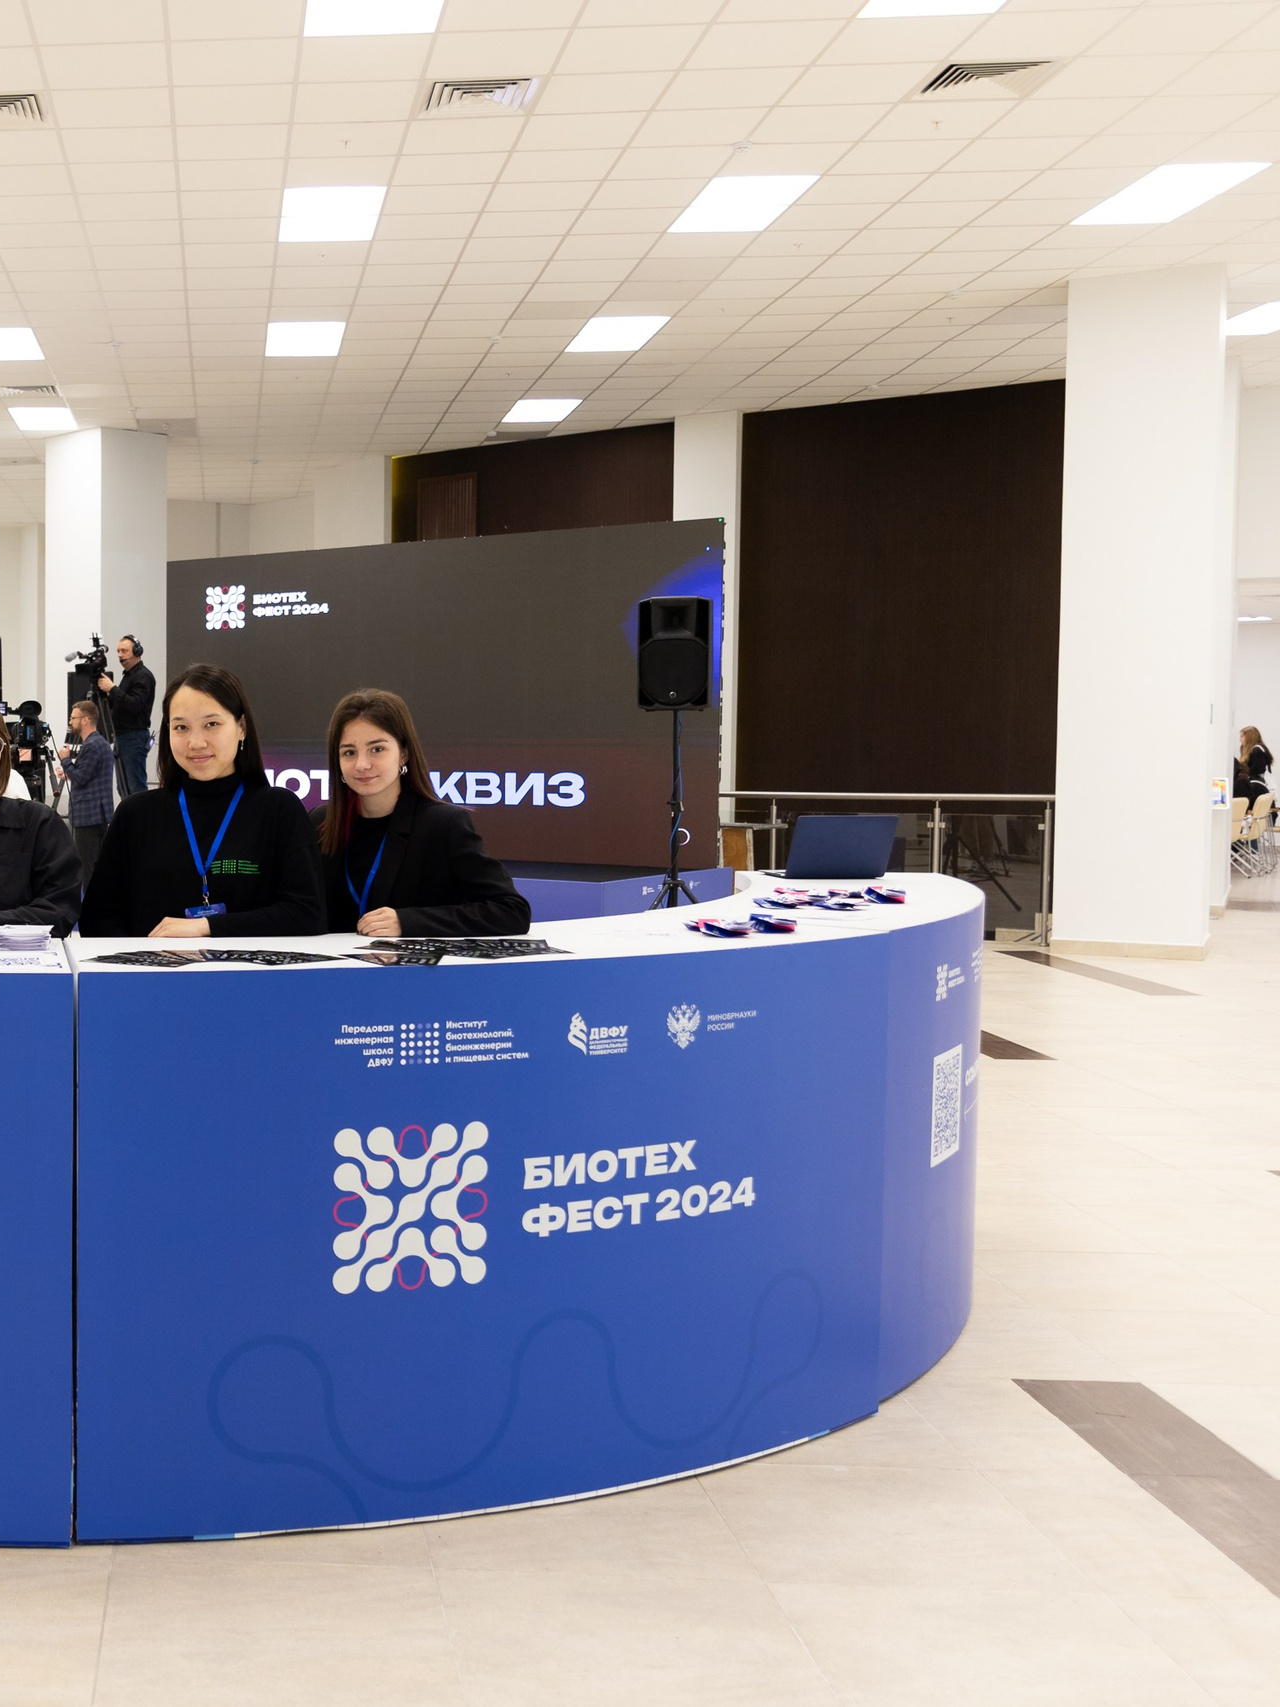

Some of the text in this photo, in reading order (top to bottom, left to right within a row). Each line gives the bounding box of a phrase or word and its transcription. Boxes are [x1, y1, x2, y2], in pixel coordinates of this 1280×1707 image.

[252, 591, 307, 605] БИОТЕХ
[252, 603, 329, 617] ФЕСТ 2024
[429, 771, 586, 808] КВИЗ
[707, 1010, 756, 1021] МИНОБРНАУКИ
[341, 1024, 394, 1035] Передовая
[445, 1020, 488, 1029] Институт
[707, 1022, 734, 1031] РОССИИ
[445, 1028, 515, 1040] биотехнологий,
[589, 1025, 628, 1040] ДВФУ
[334, 1036, 394, 1046] инженерная
[445, 1042, 512, 1051] биоинженерии
[362, 1048, 394, 1056] школа
[453, 1054, 494, 1063] пищевых
[495, 1052, 529, 1060] систем
[367, 1057, 394, 1068] ДВФУ
[522, 1139, 697, 1190] БИОТЕХ
[521, 1176, 756, 1237] ФЕСТ 2024
